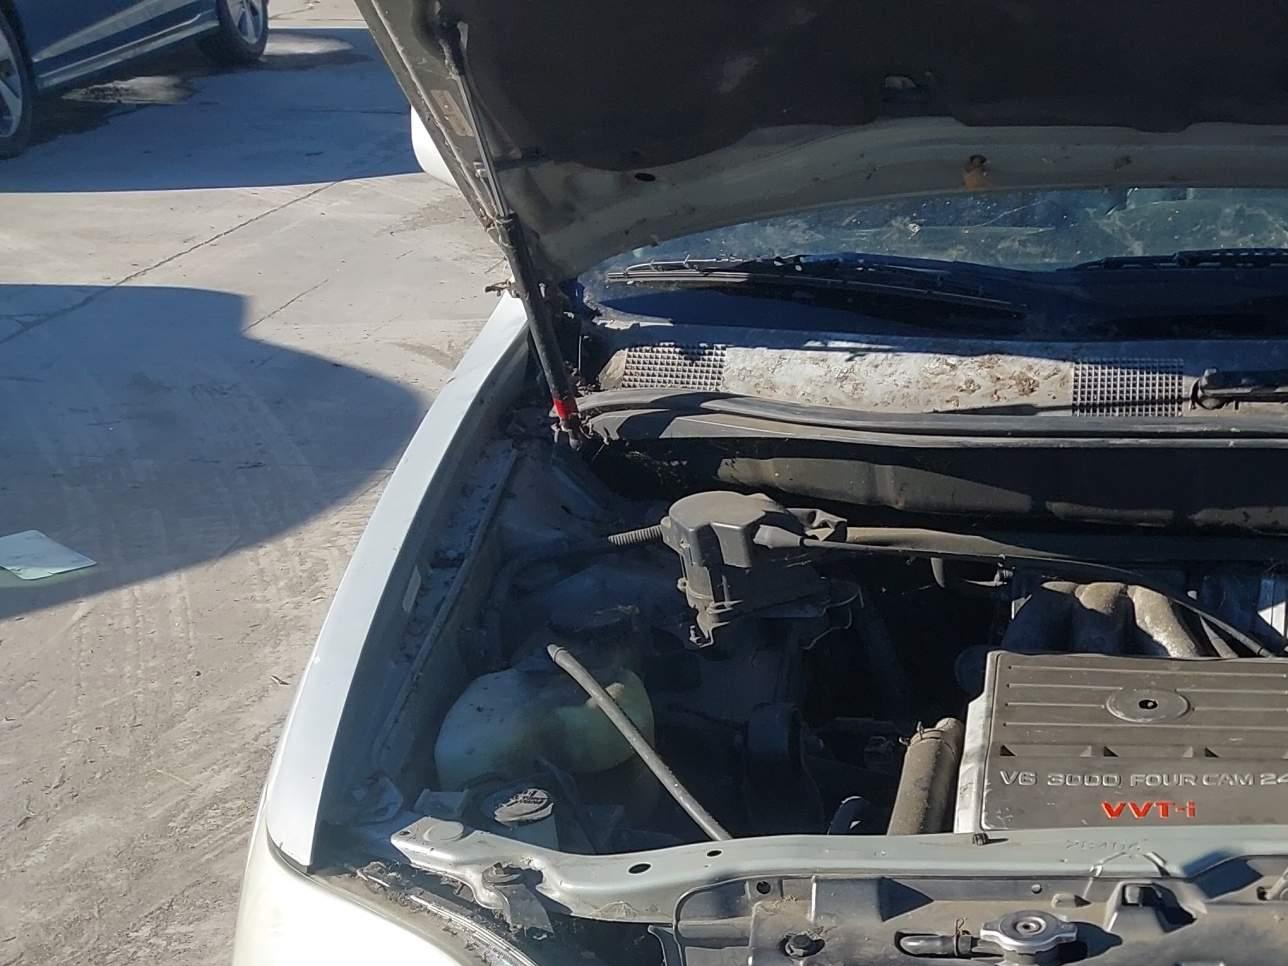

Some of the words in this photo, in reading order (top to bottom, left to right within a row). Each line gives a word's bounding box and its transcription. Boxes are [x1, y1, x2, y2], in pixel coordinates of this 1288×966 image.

[1000, 771, 1037, 786] V6
[1047, 773, 1121, 787] 3000
[1130, 773, 1196, 787] FOUR
[1202, 773, 1253, 786] CAM
[1101, 800, 1196, 819] VVT-i
